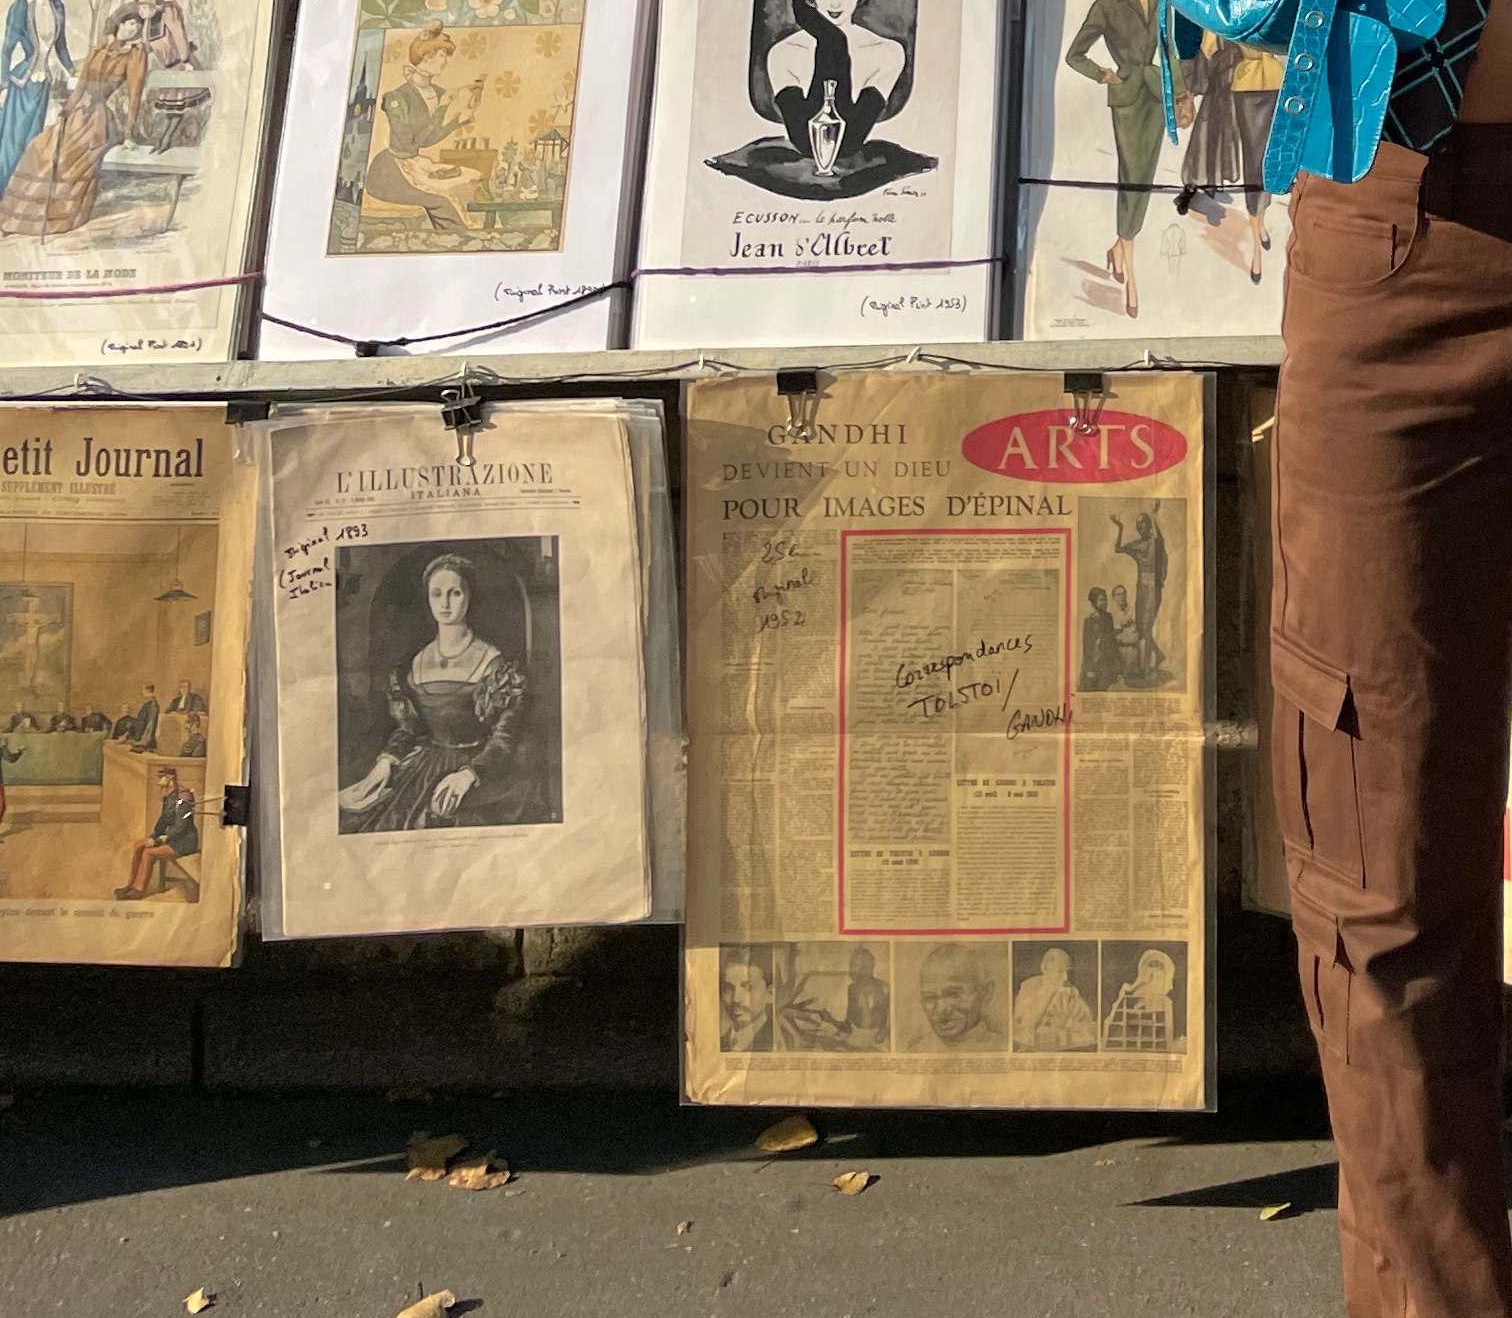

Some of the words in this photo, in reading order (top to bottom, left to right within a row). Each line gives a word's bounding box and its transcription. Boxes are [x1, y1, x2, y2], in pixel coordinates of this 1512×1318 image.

[729, 231, 784, 258] Jean
[796, 231, 893, 257] d'Albret
[3, 270, 62, 281] MONITEUR
[66, 270, 81, 280] DE
[86, 269, 100, 279] LA
[103, 268, 137, 278] MODE
[76, 437, 204, 477] Journal
[768, 424, 908, 445] GANDHI
[997, 424, 1155, 469] ARTS
[337, 463, 553, 494] L'ILLUSTRAZIONE
[723, 462, 834, 481] DEVIENT
[845, 461, 878, 477] UN
[895, 460, 951, 477] DIEU
[411, 487, 482, 500] ITALIANA
[723, 497, 802, 521] POUR
[824, 495, 926, 518] IMAGES
[946, 491, 1073, 517] D'ÉPINAL
[335, 523, 369, 542] 1893
[896, 634, 1034, 689] Correspondances
